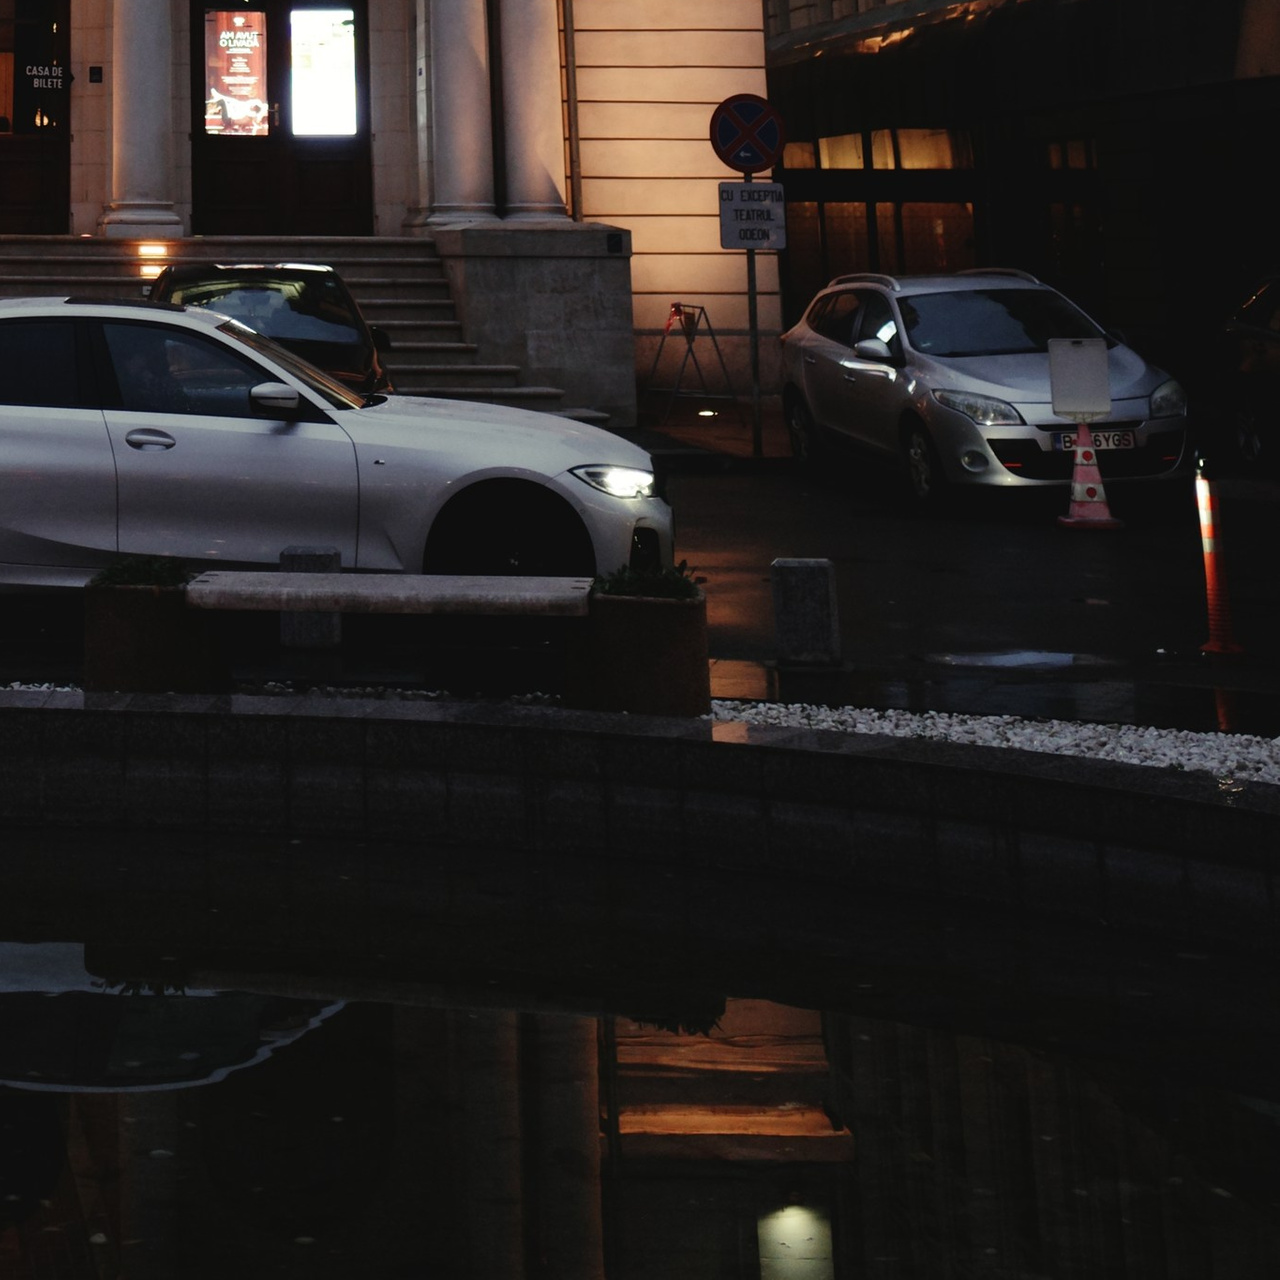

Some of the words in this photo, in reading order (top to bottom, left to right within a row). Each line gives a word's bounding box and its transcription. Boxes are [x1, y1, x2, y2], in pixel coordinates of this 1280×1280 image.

[26, 65, 50, 76] CASA
[52, 66, 63, 77] DE
[33, 78, 63, 89] BILETE
[721, 190, 734, 201] CU
[733, 209, 775, 222] TEATRUL
[739, 228, 770, 241] ODEON
